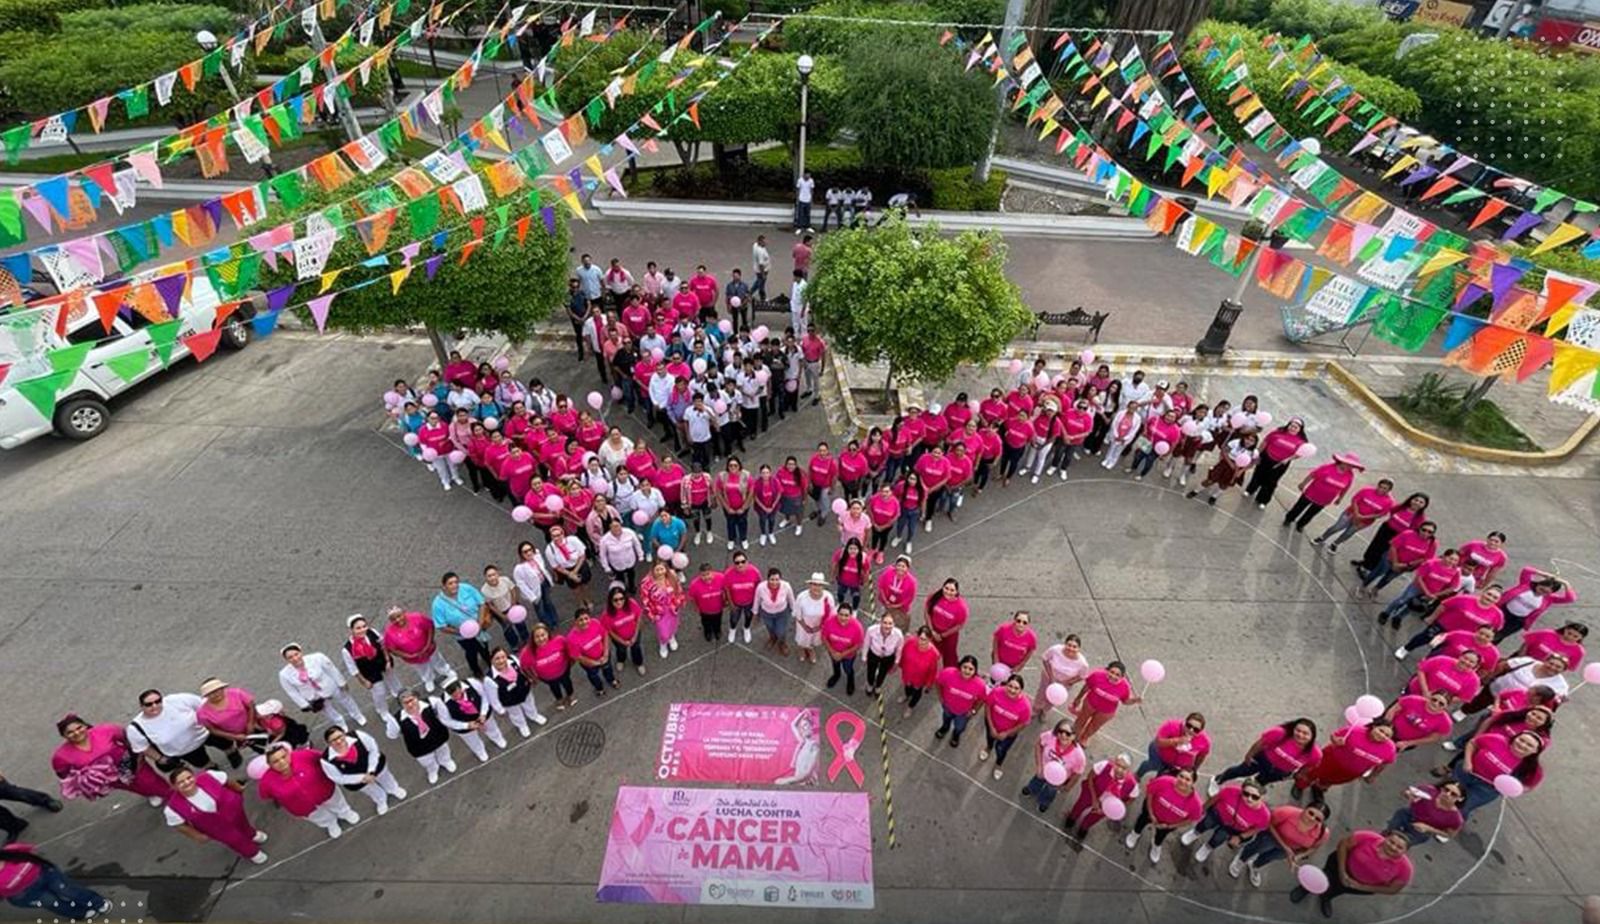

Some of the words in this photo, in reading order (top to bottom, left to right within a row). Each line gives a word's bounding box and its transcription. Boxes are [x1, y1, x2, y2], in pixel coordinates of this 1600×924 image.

[658, 703, 682, 779] OCTUBRE
[666, 811, 801, 843] CÁNCER
[716, 808, 753, 817] LUCHA
[755, 808, 802, 819] CONTRA
[691, 843, 800, 872] MAMA
